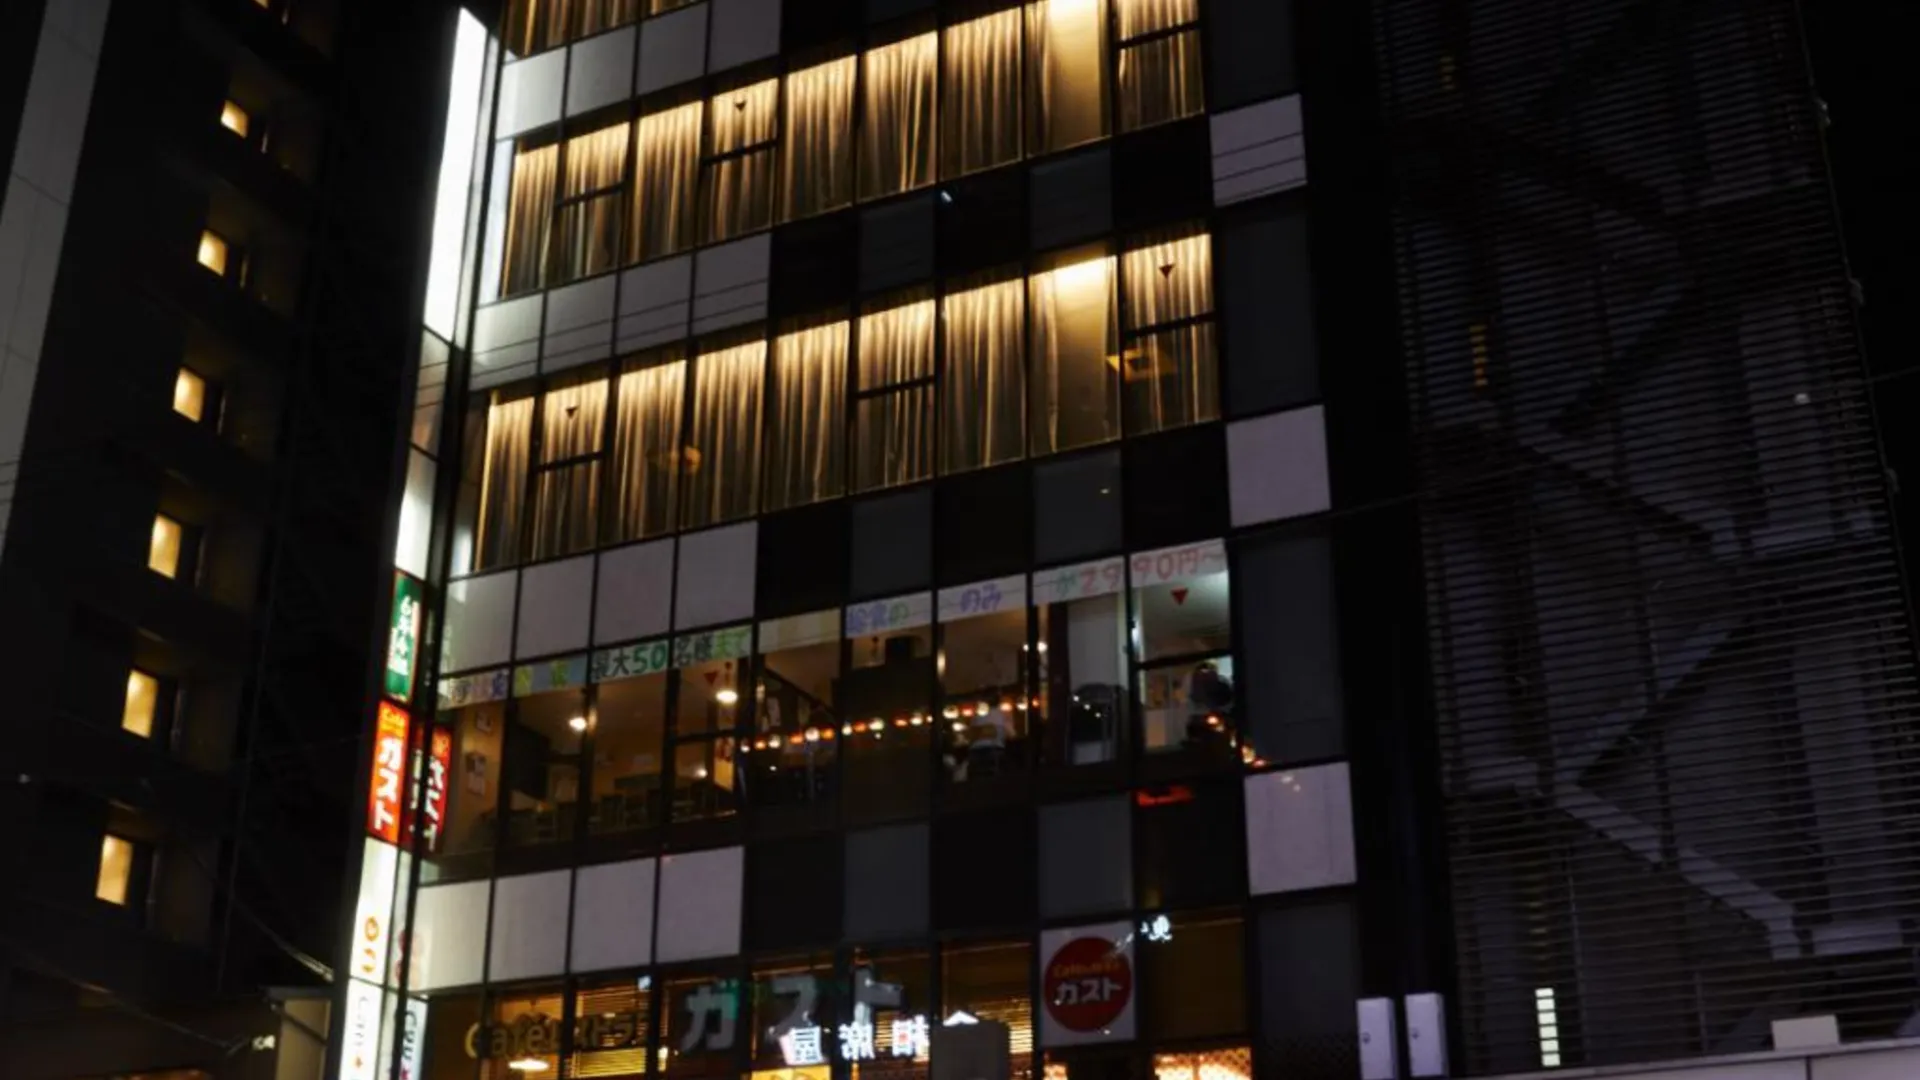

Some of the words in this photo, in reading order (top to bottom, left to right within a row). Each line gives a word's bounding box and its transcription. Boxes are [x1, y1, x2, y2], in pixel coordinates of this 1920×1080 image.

[373, 736, 404, 831] ガスト
[680, 966, 904, 1051] ガスト
